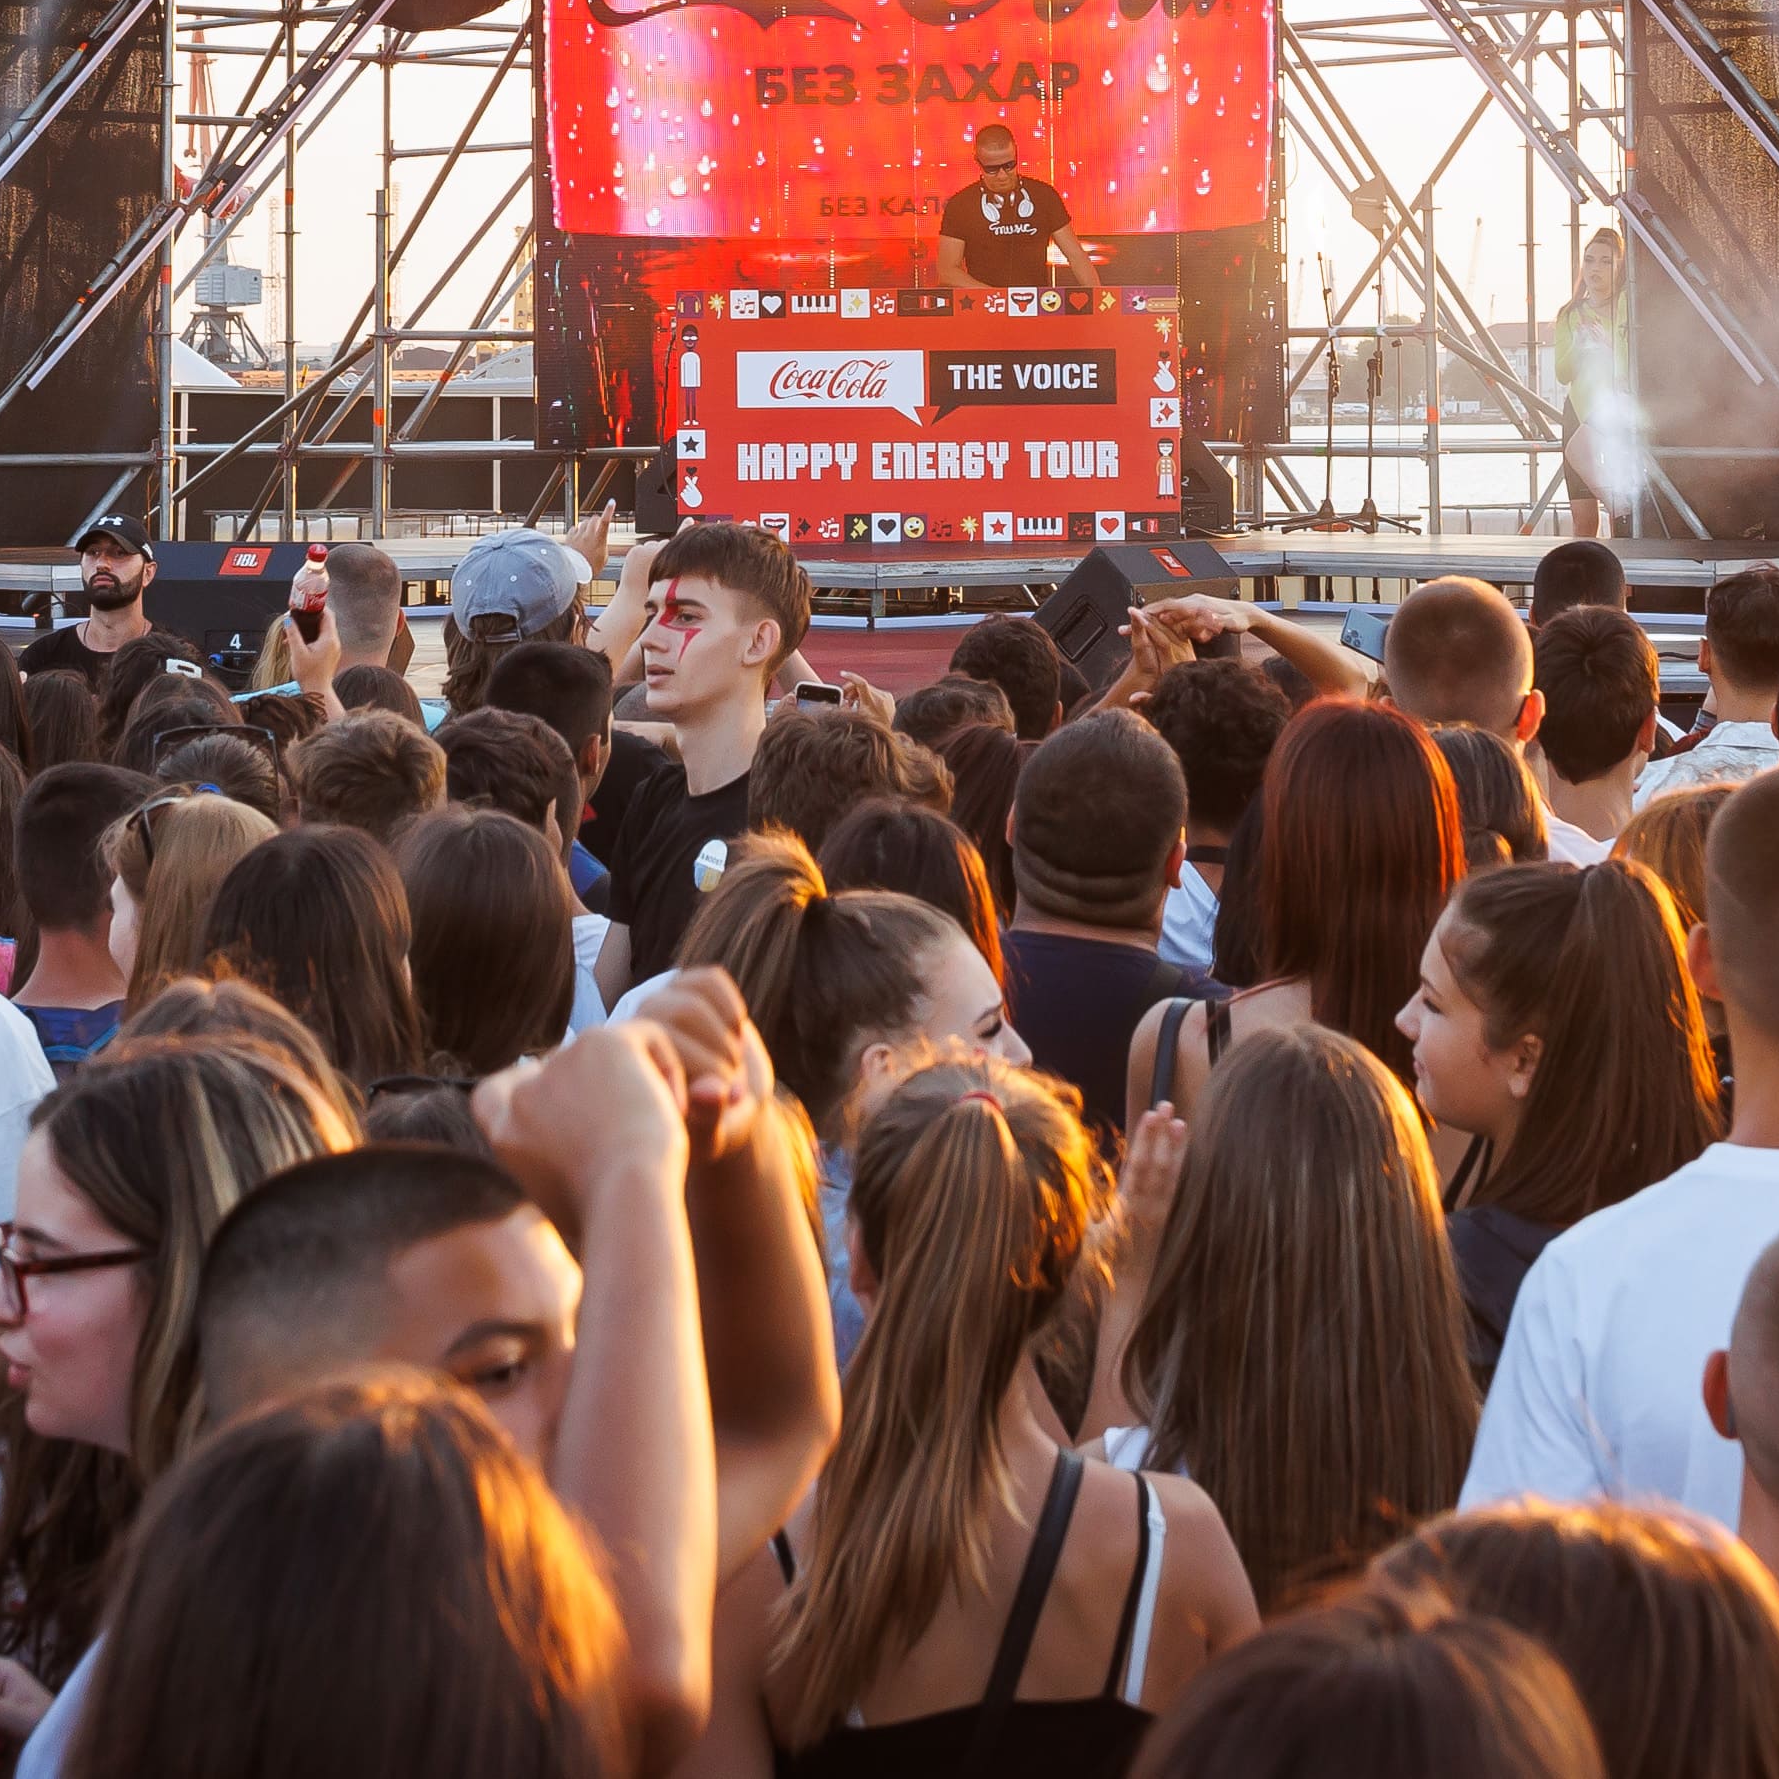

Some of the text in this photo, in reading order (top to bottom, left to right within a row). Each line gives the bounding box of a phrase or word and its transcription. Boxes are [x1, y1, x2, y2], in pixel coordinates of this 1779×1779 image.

[755, 61, 1080, 106] БЕЗ ЗАХАР
[819, 196, 868, 217] БЕЗ
[769, 359, 894, 400] Coca-Cola
[947, 362, 1098, 391] THE VOICE
[736, 440, 1119, 481] HAPPY ENERGY TOUR
[230, 633, 242, 650] 4
